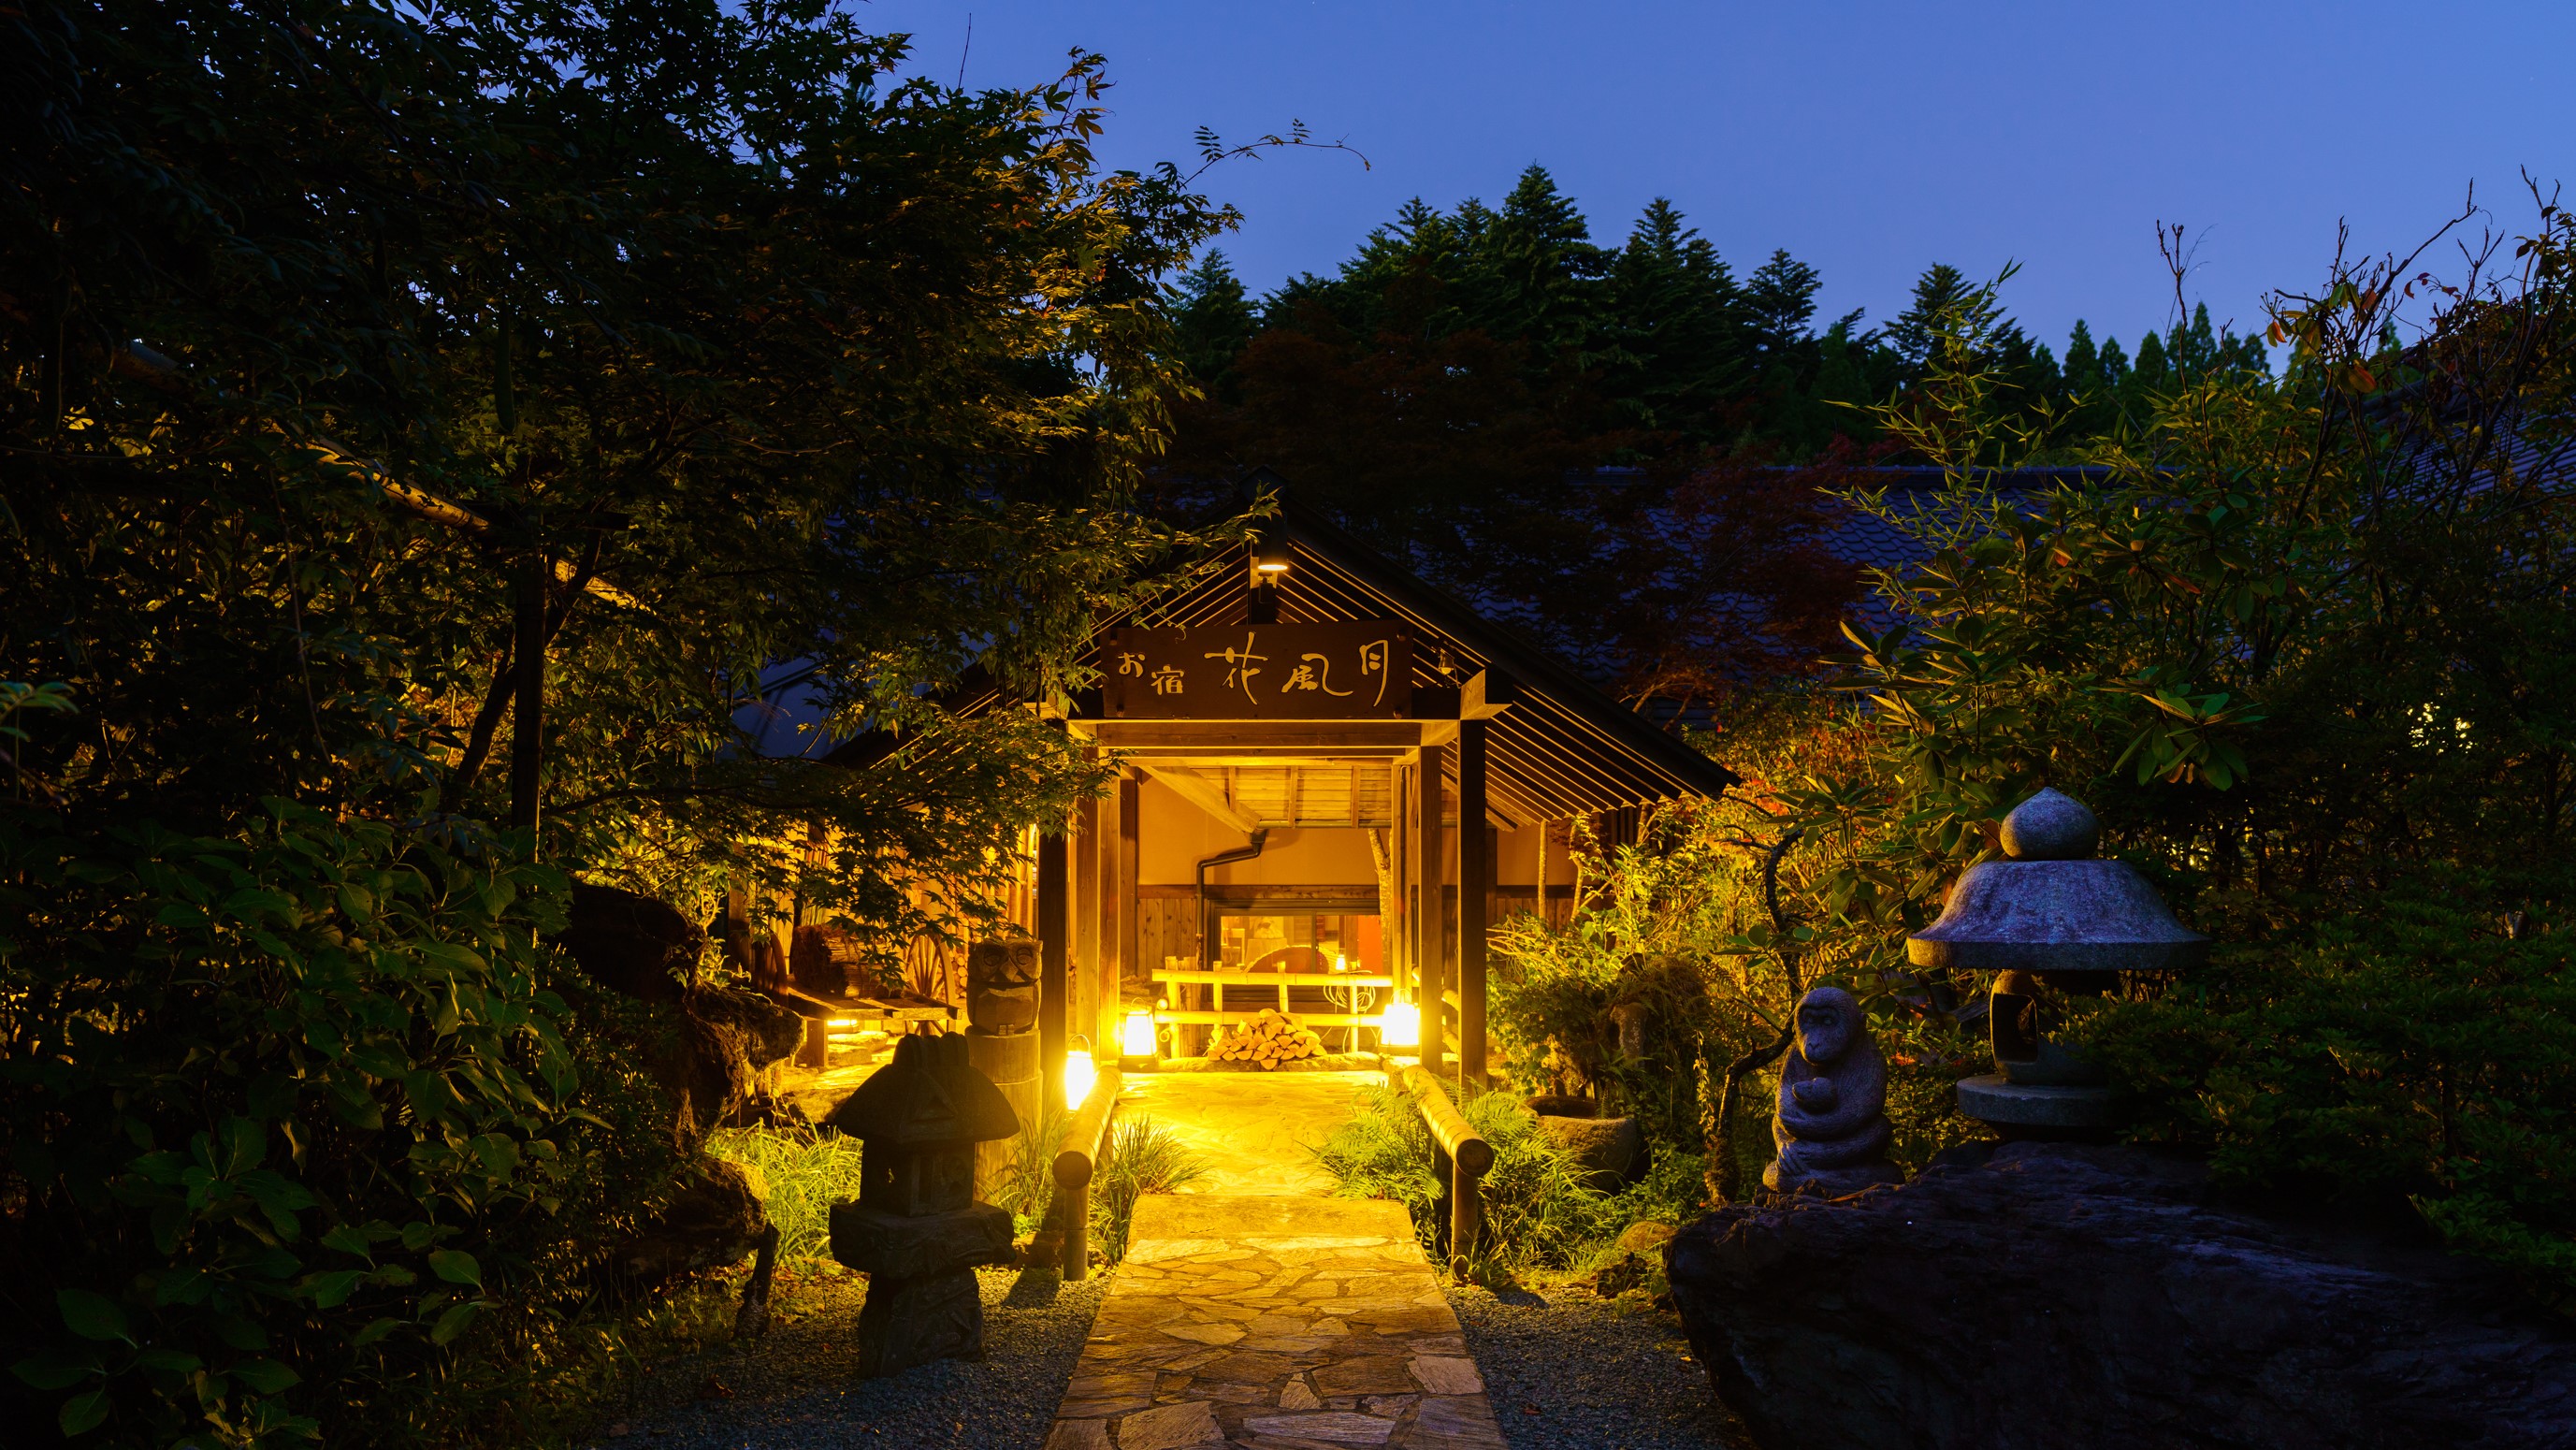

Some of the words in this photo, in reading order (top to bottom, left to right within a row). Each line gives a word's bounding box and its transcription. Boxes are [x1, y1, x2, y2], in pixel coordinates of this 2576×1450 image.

[1117, 651, 1185, 696] お宿
[1204, 631, 1389, 707] 花風月
